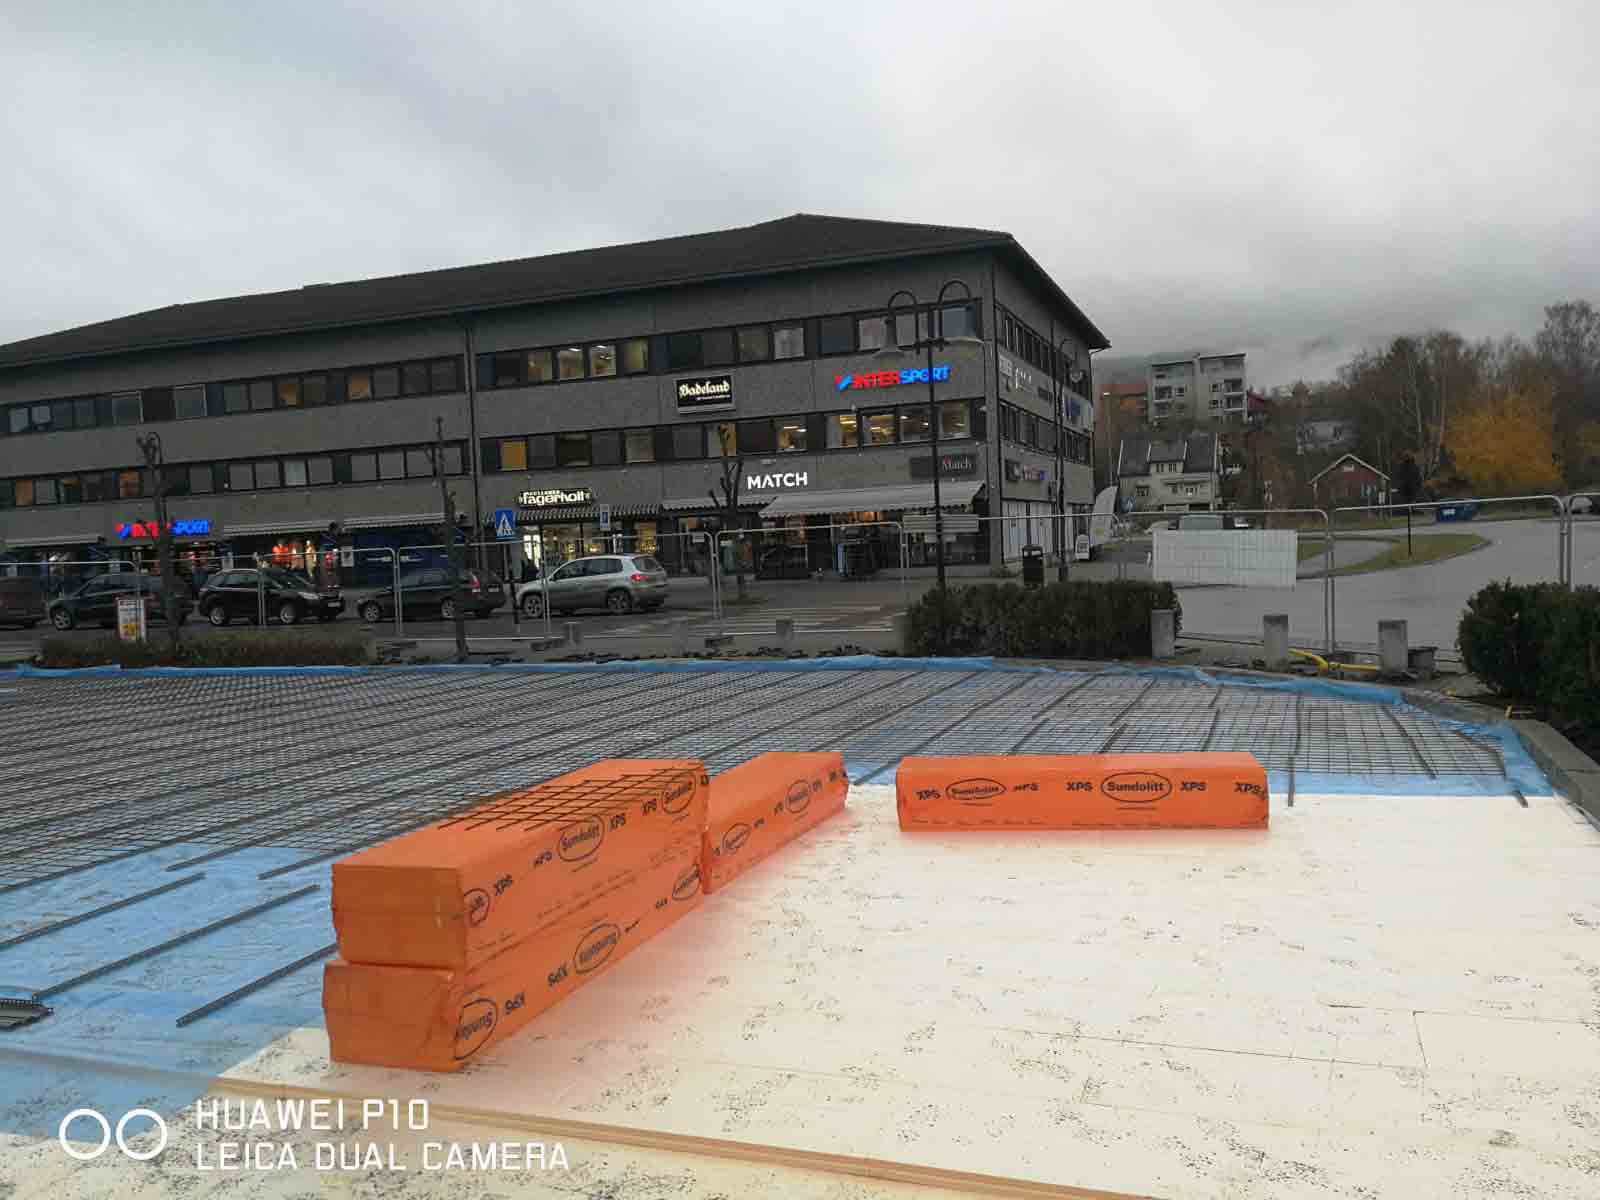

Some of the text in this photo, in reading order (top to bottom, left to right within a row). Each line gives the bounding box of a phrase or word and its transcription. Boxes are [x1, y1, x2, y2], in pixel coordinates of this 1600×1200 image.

[747, 471, 808, 489] MATCH
[915, 788, 941, 800] XPS
[1066, 781, 1092, 791] XPS
[1180, 781, 1206, 791] XPS
[609, 812, 627, 831] XPS
